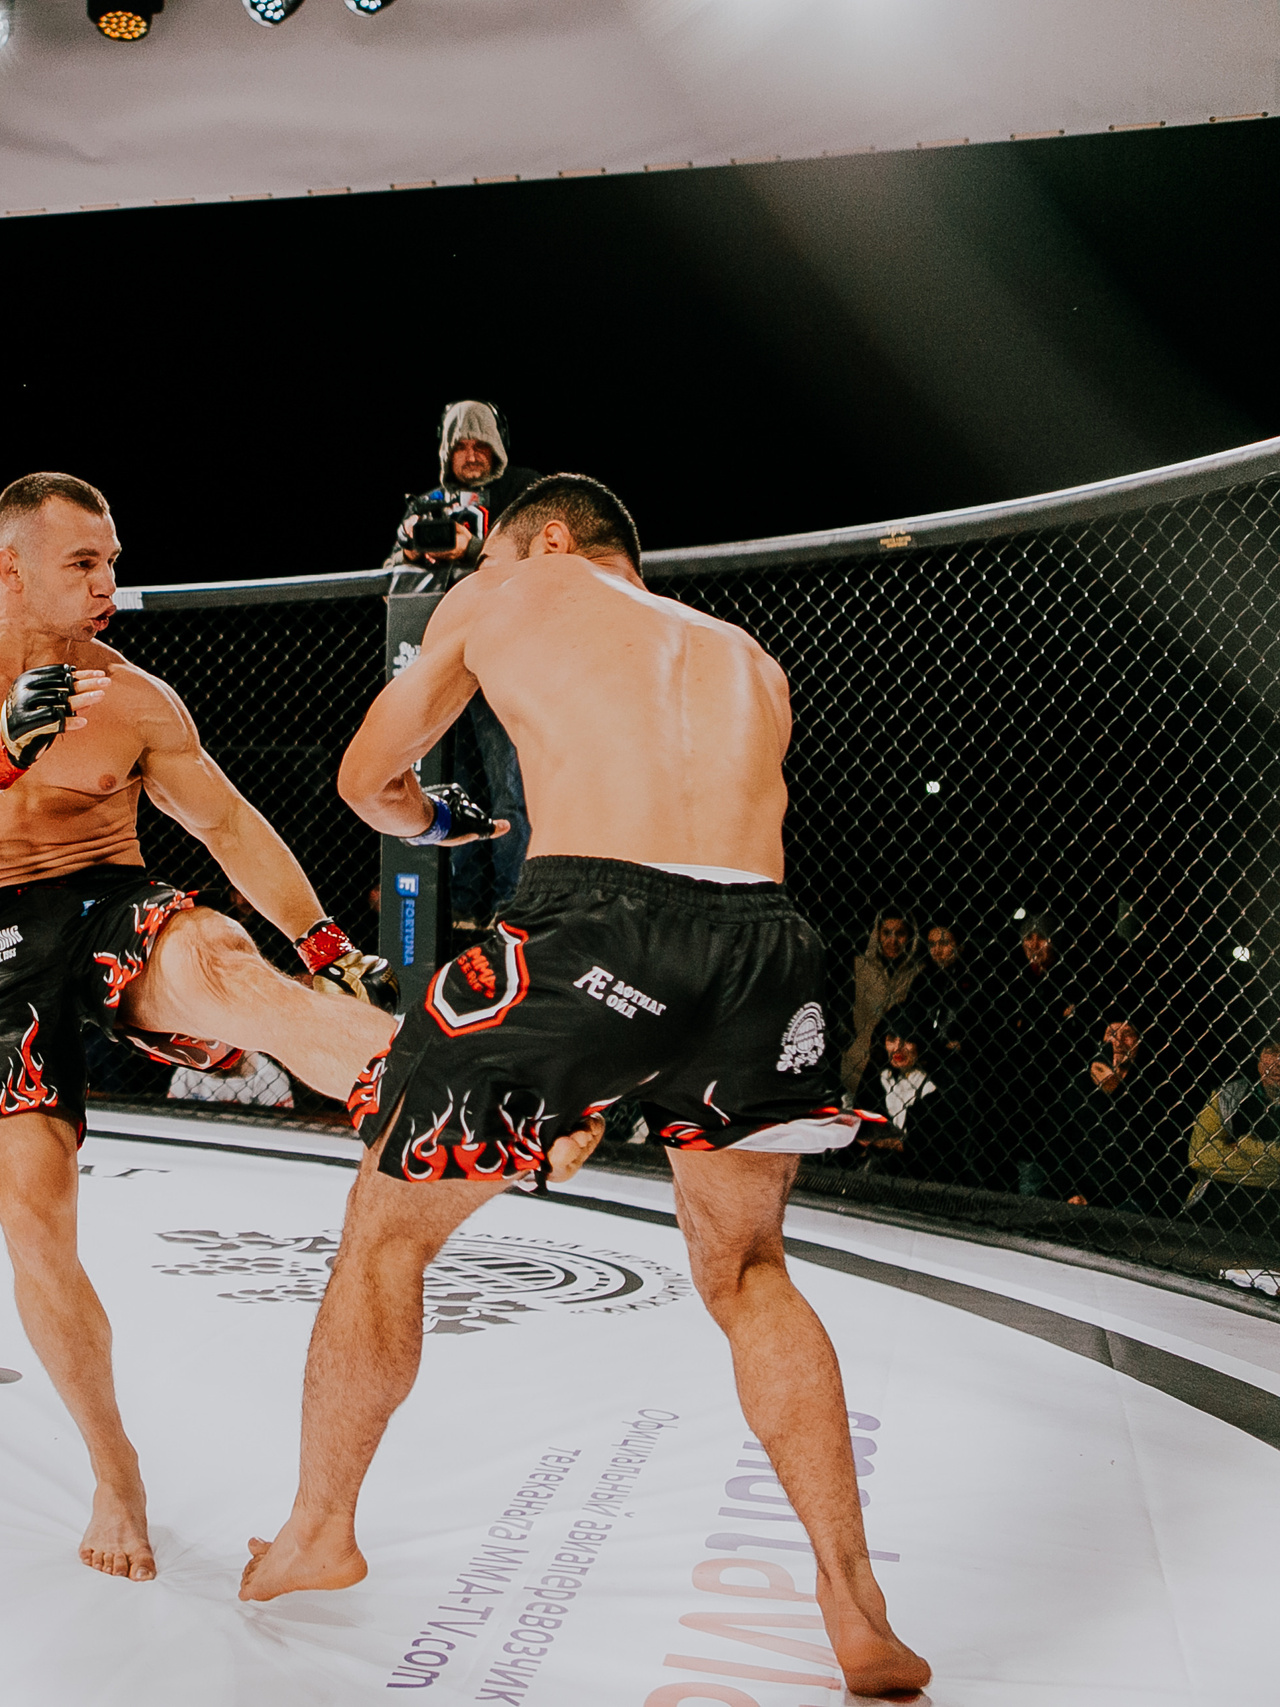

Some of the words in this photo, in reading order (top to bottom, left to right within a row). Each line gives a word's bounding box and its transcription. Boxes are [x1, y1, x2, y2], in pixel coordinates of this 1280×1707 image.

[403, 899, 415, 966] FORTUNA
[488, 1446, 582, 1542] телеканала
[582, 1408, 680, 1519] Официальный
[386, 1543, 530, 1689] MMA-TV.com
[475, 1519, 613, 1707] авиаперевозчик
